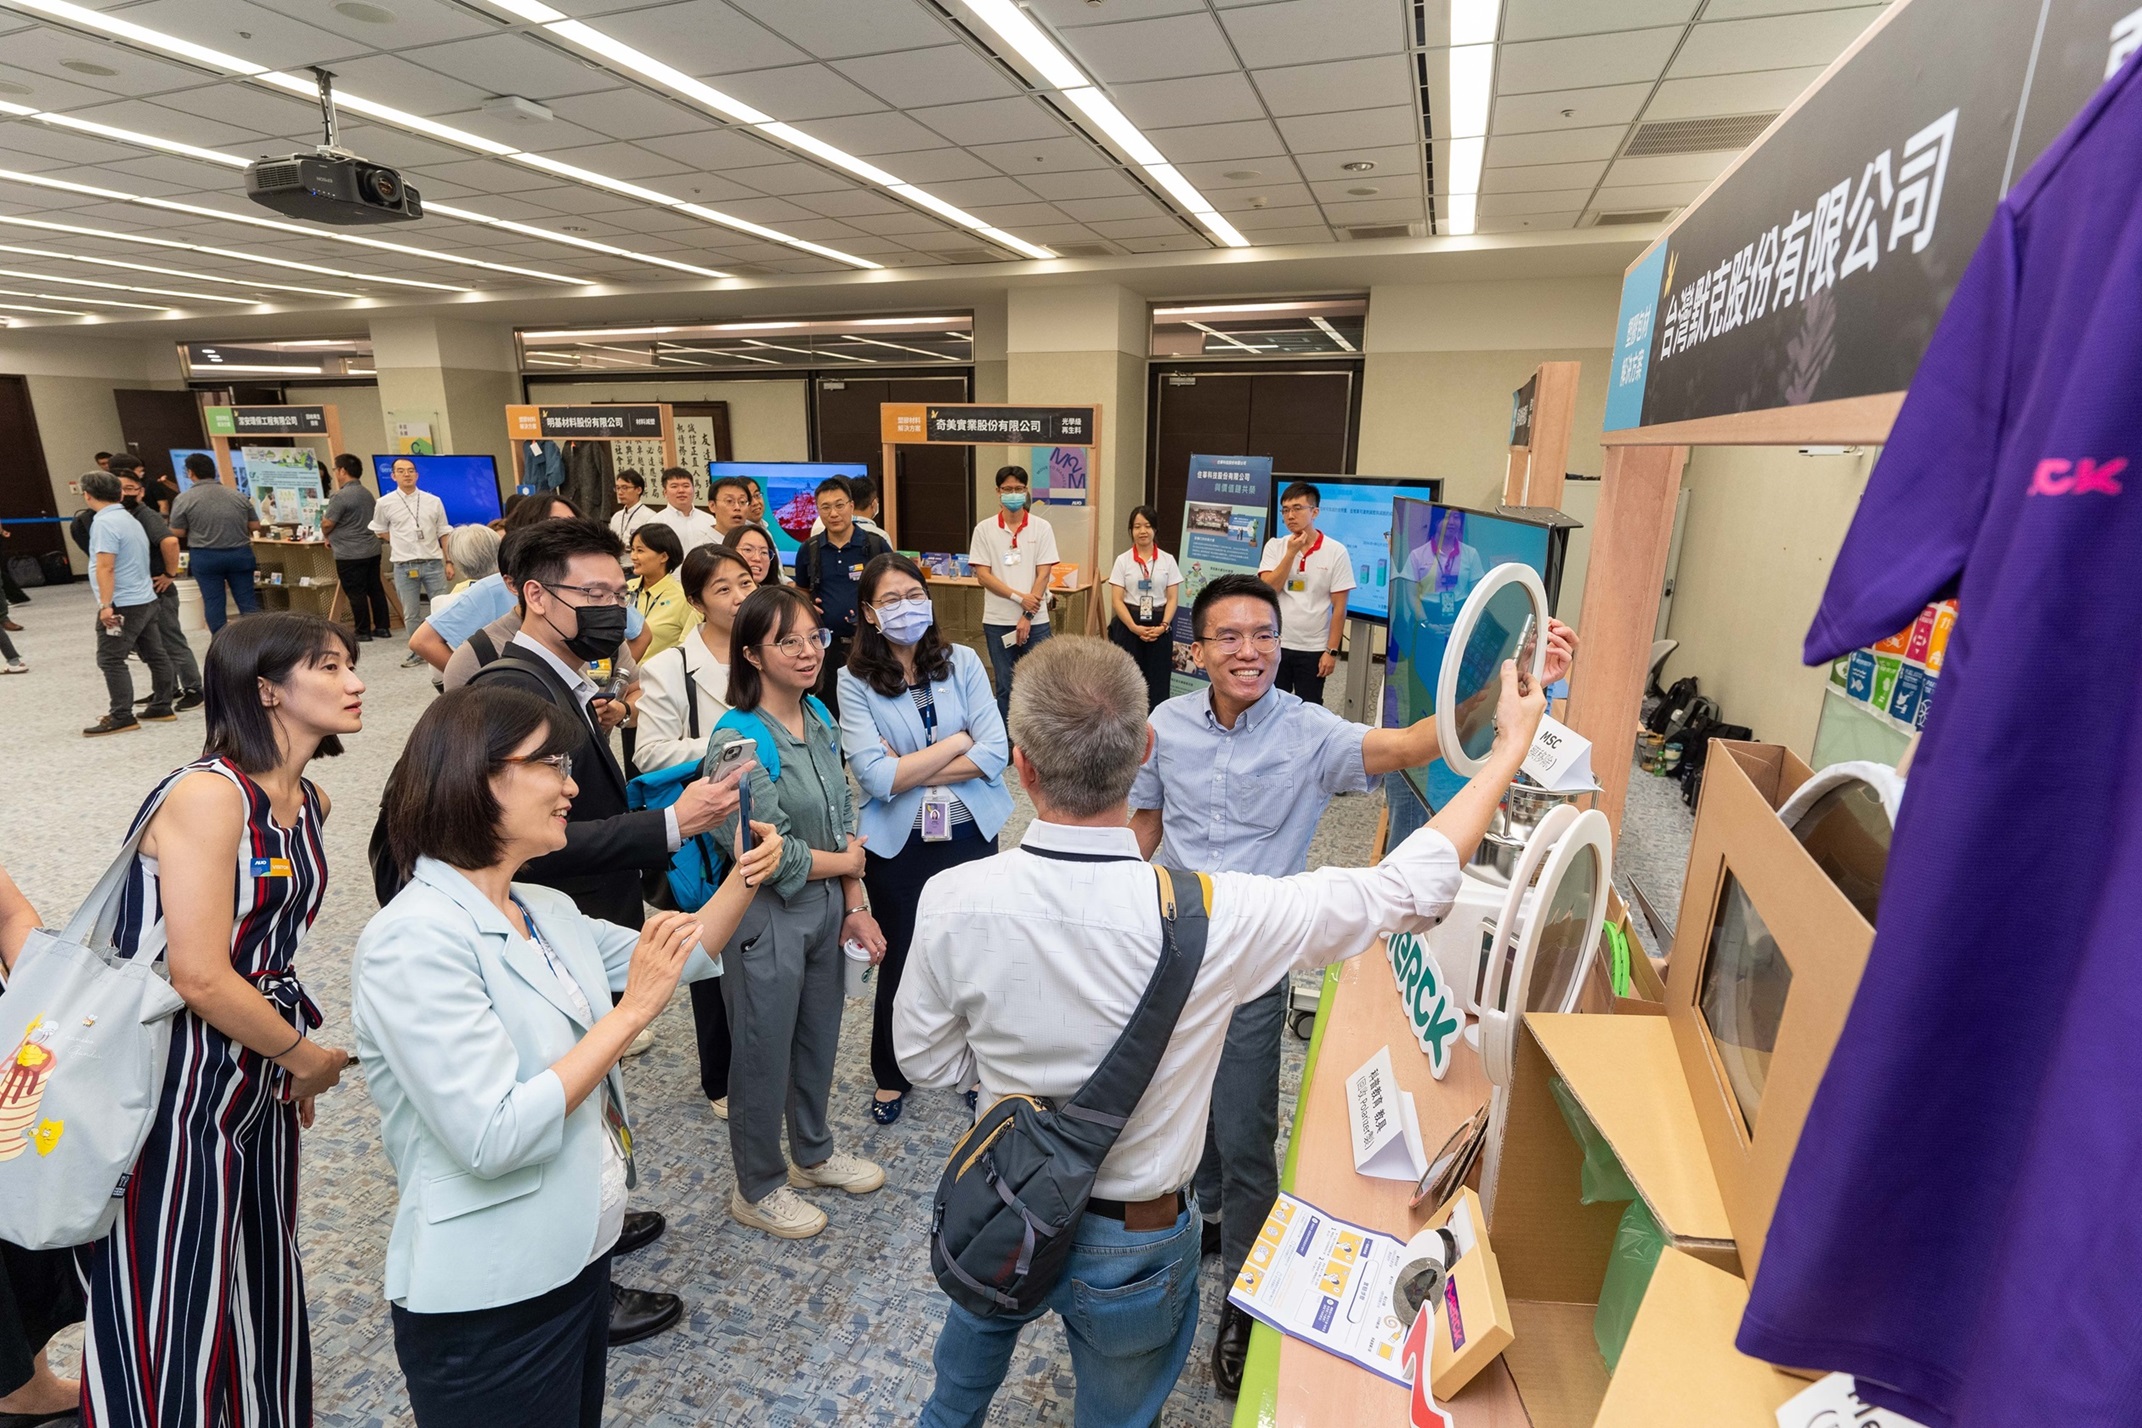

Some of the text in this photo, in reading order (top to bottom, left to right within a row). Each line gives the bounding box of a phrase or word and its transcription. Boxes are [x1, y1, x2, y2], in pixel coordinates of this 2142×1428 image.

[1660, 109, 1959, 360] 台灣默克股份有限公司
[546, 417, 623, 428] 明基材料股份有限公司
[936, 419, 1041, 433] 奇美實業股份有限公司
[1061, 417, 1082, 426] 光學級
[1061, 426, 1082, 435] 再生料
[1050, 447, 1086, 489] M2M
[2027, 457, 2128, 497] CK
[1539, 731, 1562, 749] MSC
[1368, 1068, 1388, 1135] 科普教育 教具
[1446, 1282, 1463, 1344] MERCK
